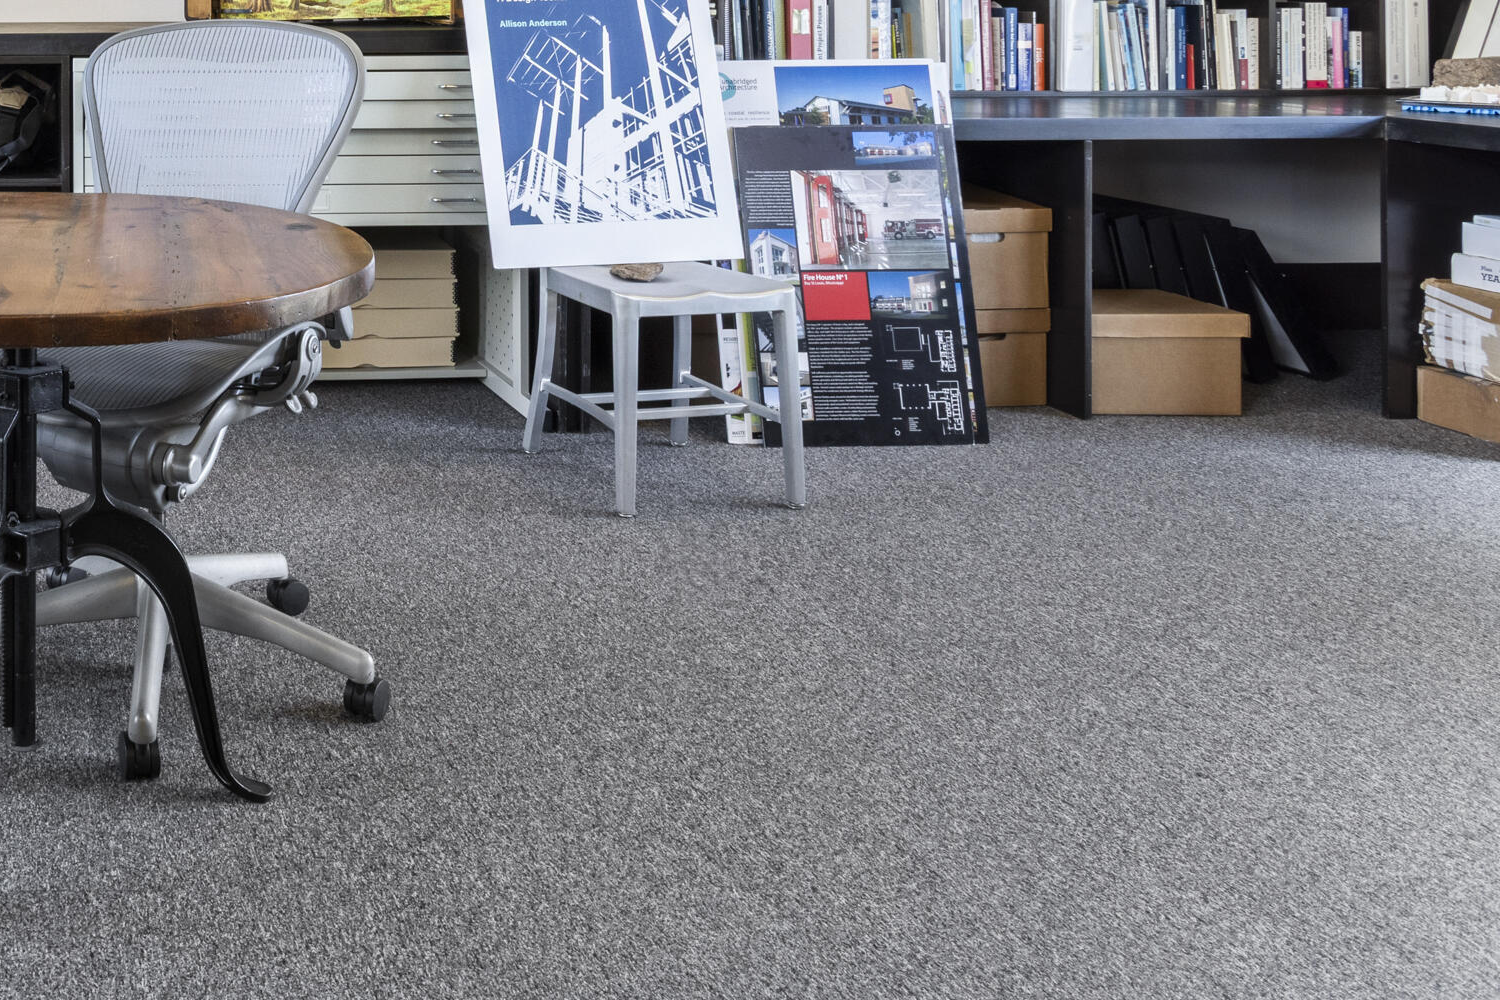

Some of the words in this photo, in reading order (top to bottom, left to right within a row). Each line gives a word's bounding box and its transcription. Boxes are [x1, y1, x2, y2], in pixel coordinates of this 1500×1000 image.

[500, 19, 527, 28] Allison
[529, 19, 567, 28] Anderson
[803, 273, 815, 281] Fire
[815, 273, 836, 281] House
